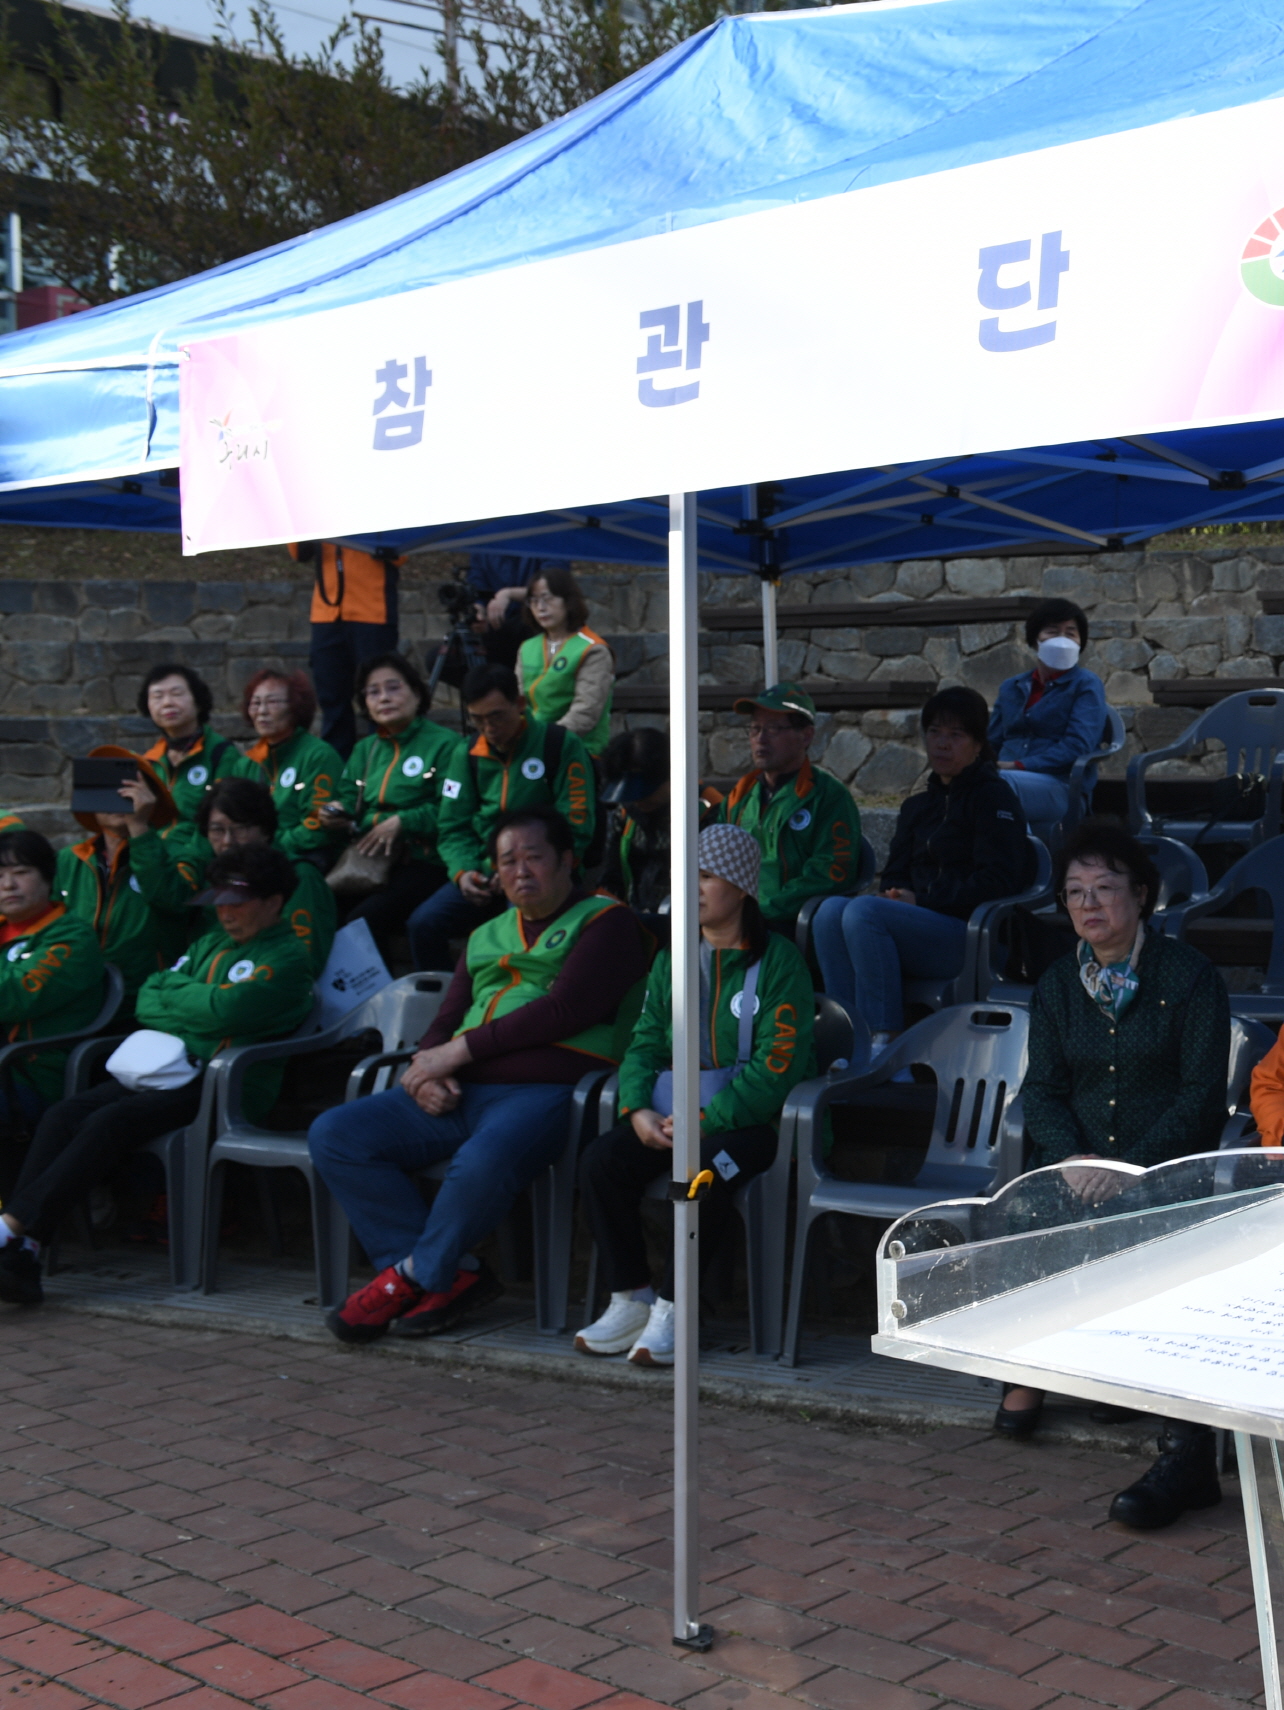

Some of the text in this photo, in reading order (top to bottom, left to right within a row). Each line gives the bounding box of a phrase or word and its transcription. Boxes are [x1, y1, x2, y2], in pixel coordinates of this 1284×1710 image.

[372, 229, 1070, 451] 참 관 단
[567, 762, 587, 825] CAIND
